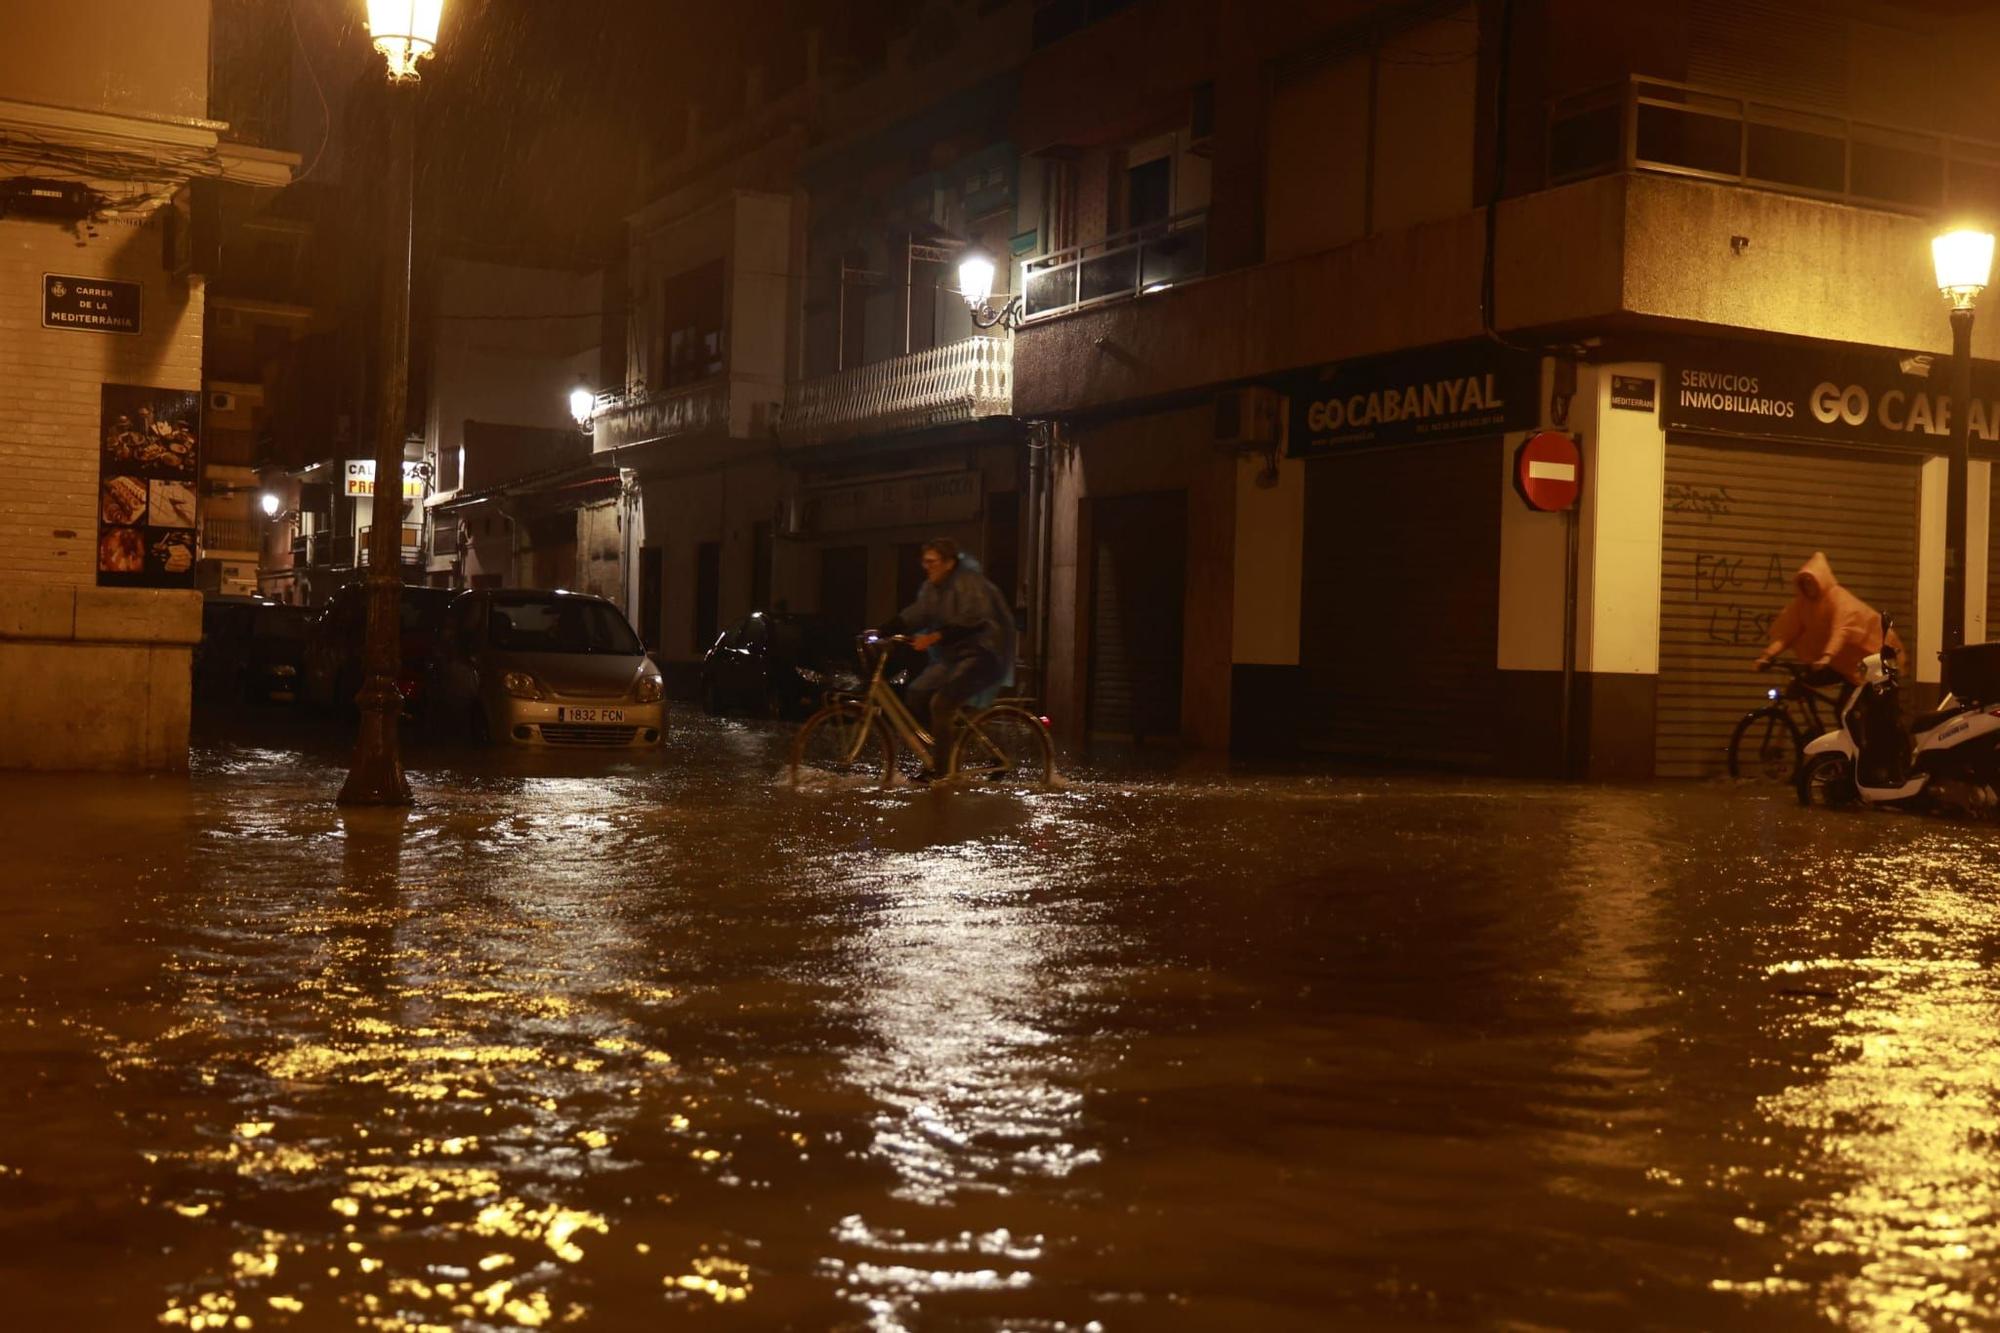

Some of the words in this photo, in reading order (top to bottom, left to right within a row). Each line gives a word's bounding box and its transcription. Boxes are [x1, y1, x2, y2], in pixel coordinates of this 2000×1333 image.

[76, 287, 113, 298] CARRER
[79, 300, 92, 309] DE
[96, 302, 108, 310] LA
[1681, 370, 1759, 394] SERVICIOS
[1307, 399, 1344, 433] GO
[1346, 373, 1503, 428] CABANYAL
[1680, 390, 1794, 418] INMOBILIARIOS
[1809, 381, 1870, 427] GO
[1762, 552, 1785, 592] A
[569, 709, 597, 721] 1832
[601, 709, 623, 721] FCN
